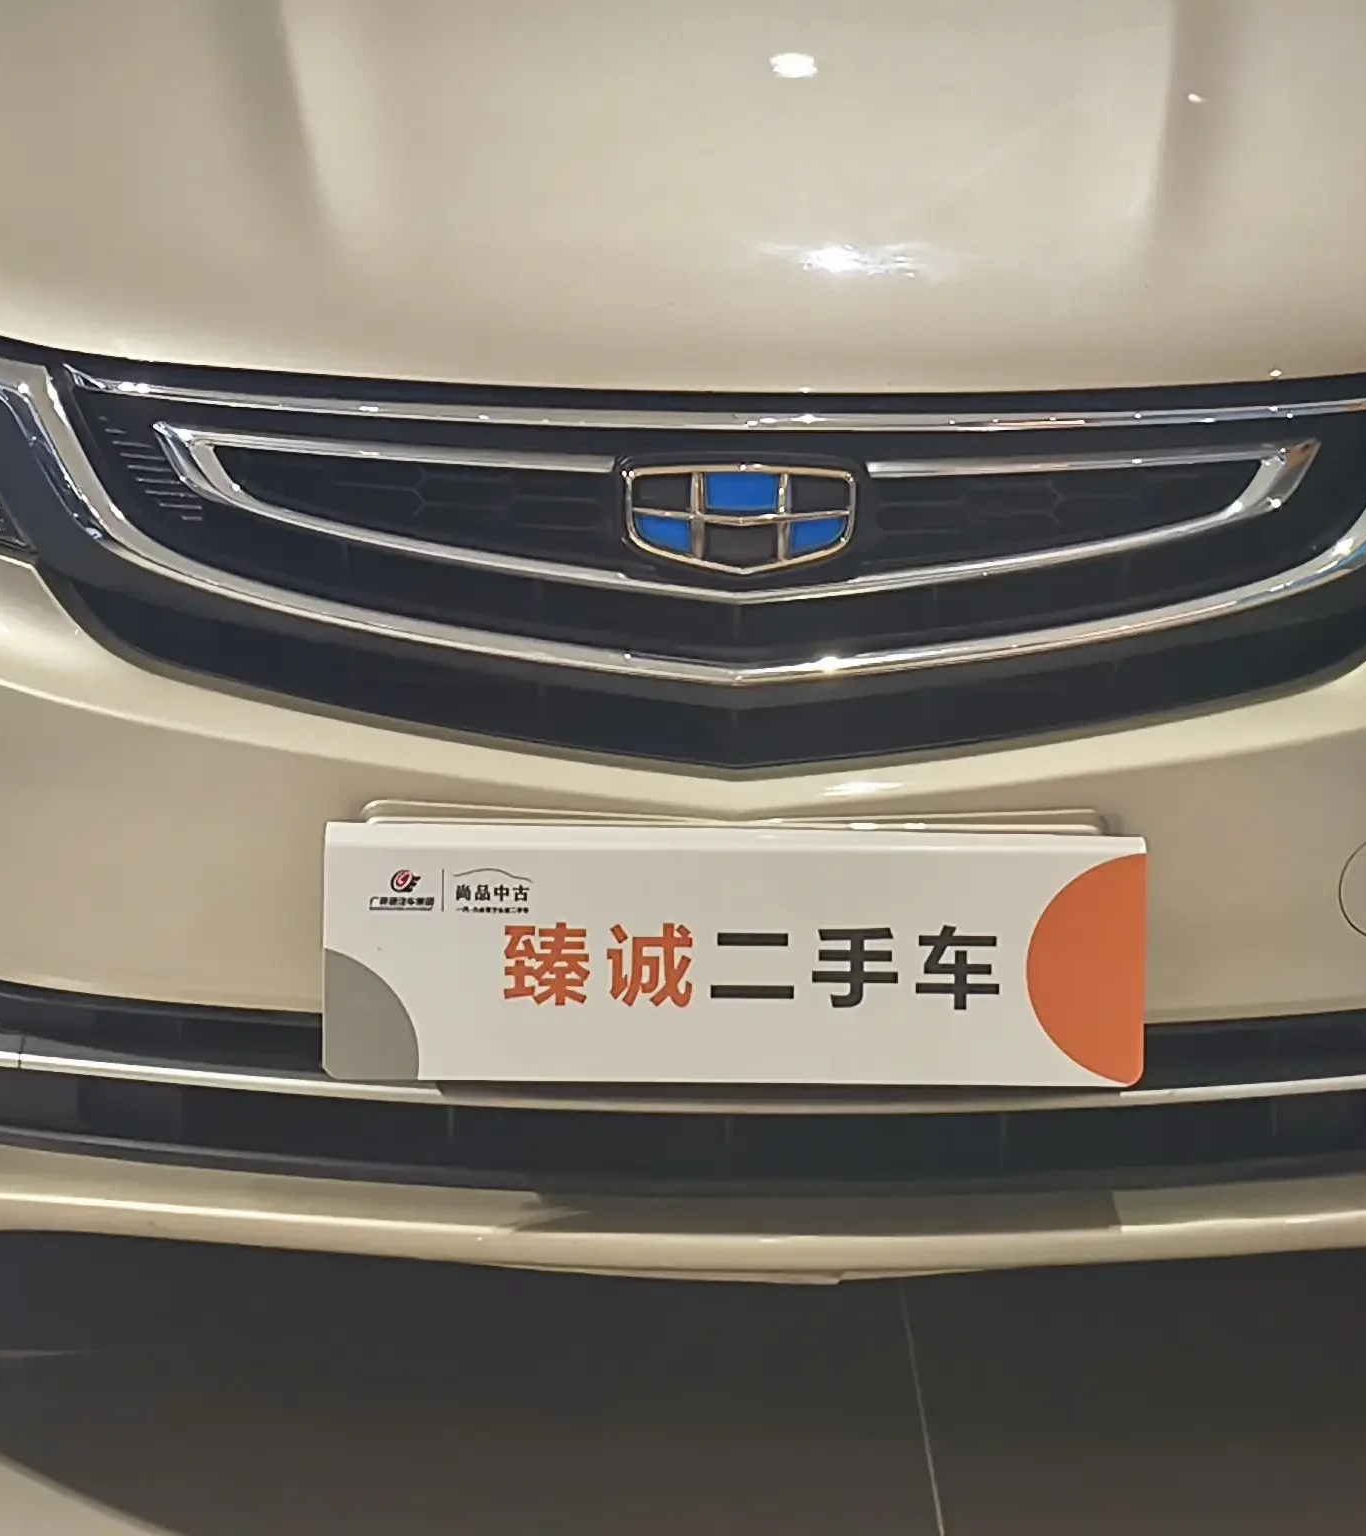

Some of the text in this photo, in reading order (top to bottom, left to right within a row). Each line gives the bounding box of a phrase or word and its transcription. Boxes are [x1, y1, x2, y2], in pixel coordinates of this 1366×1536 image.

[502, 922, 1001, 1010] 臻诚二手车
